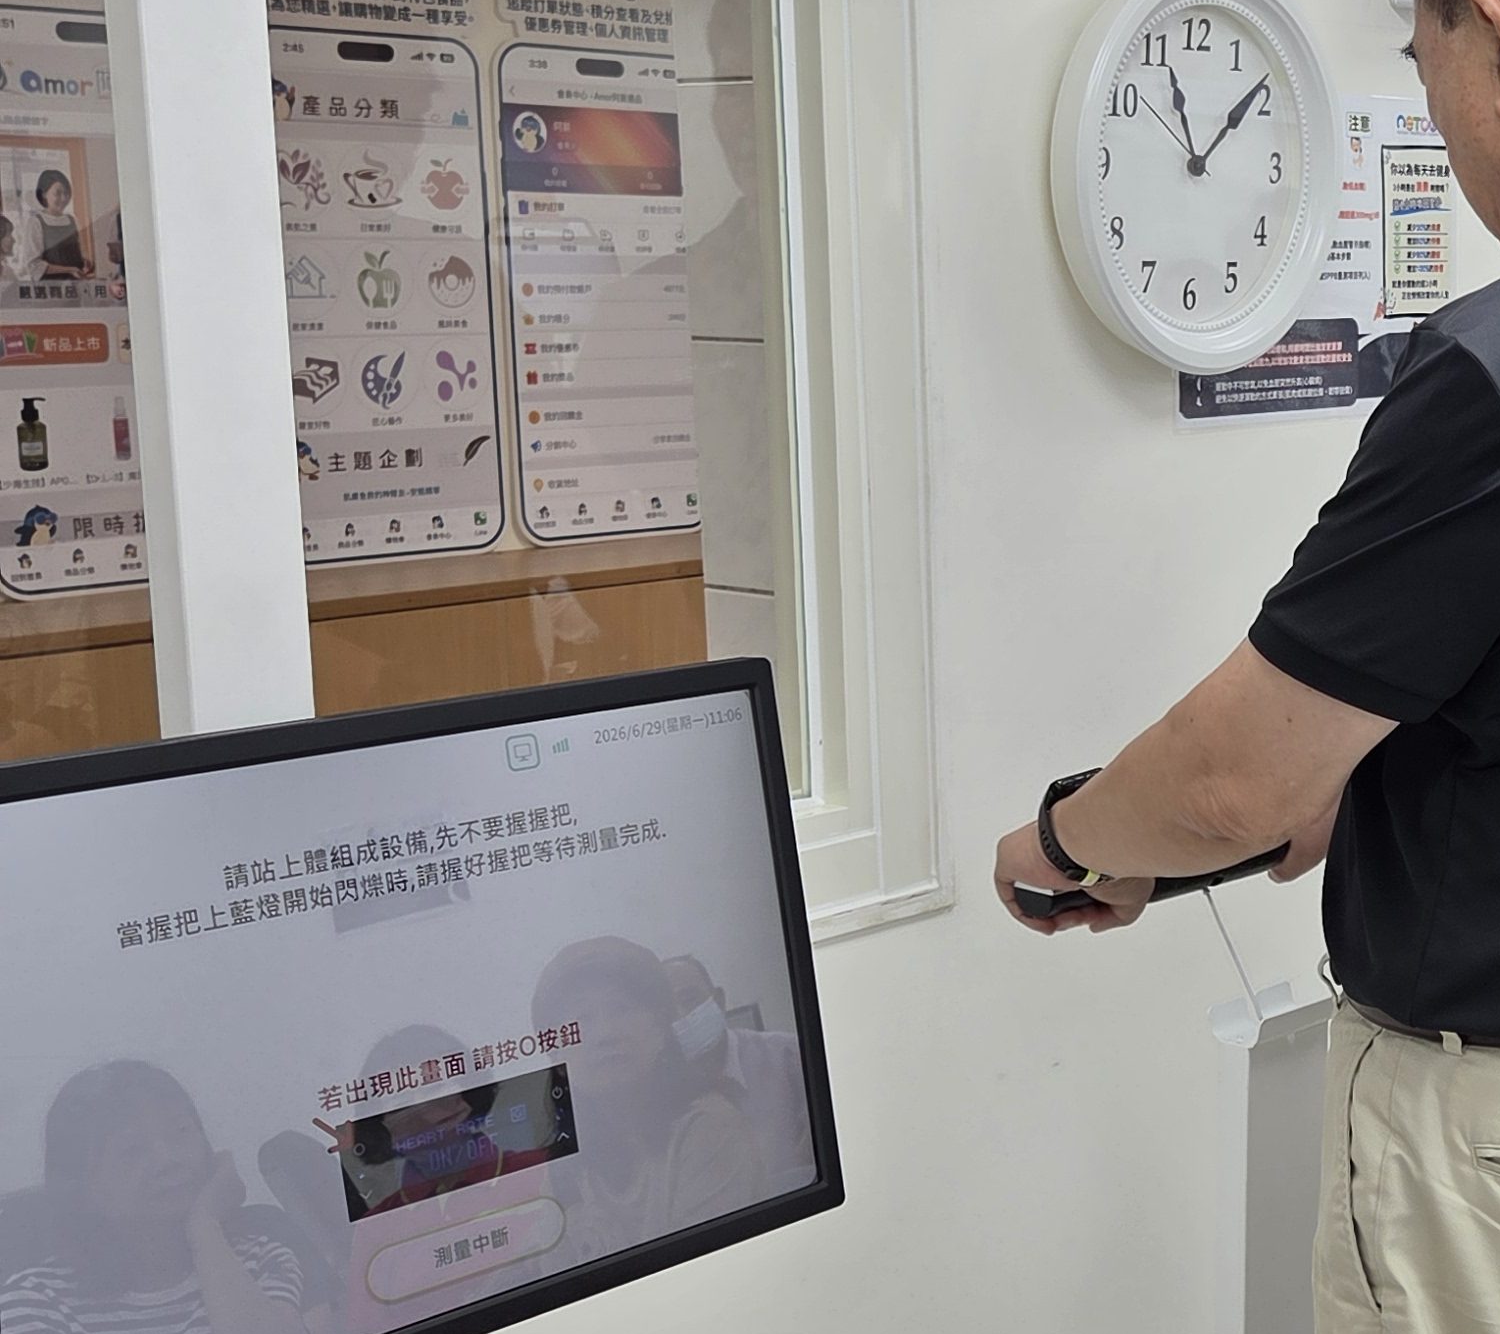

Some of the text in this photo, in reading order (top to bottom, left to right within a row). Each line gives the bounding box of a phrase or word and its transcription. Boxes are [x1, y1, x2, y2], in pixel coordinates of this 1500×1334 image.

[1140, 32, 1170, 67] 11
[1182, 17, 1212, 52] 12
[1229, 39, 1243, 72] 1
[302, 95, 400, 119] 產品分類
[1107, 83, 1138, 118] 10
[1257, 83, 1272, 116] 2
[1349, 114, 1370, 132] 注意
[1269, 151, 1282, 184] 3
[1390, 163, 1450, 178] 你以為每天去健身
[1110, 216, 1125, 250] 8
[1253, 215, 1267, 247] 4
[1141, 260, 1157, 294] 7
[1182, 277, 1197, 310] 6
[1224, 261, 1238, 294] 5
[43, 337, 100, 352] 新品上市
[327, 447, 423, 473] 主題企劃
[394, 1117, 495, 1152] HEART RATE
[429, 1133, 499, 1171] ON/OFF
[433, 1226, 510, 1268] 測量中斷
